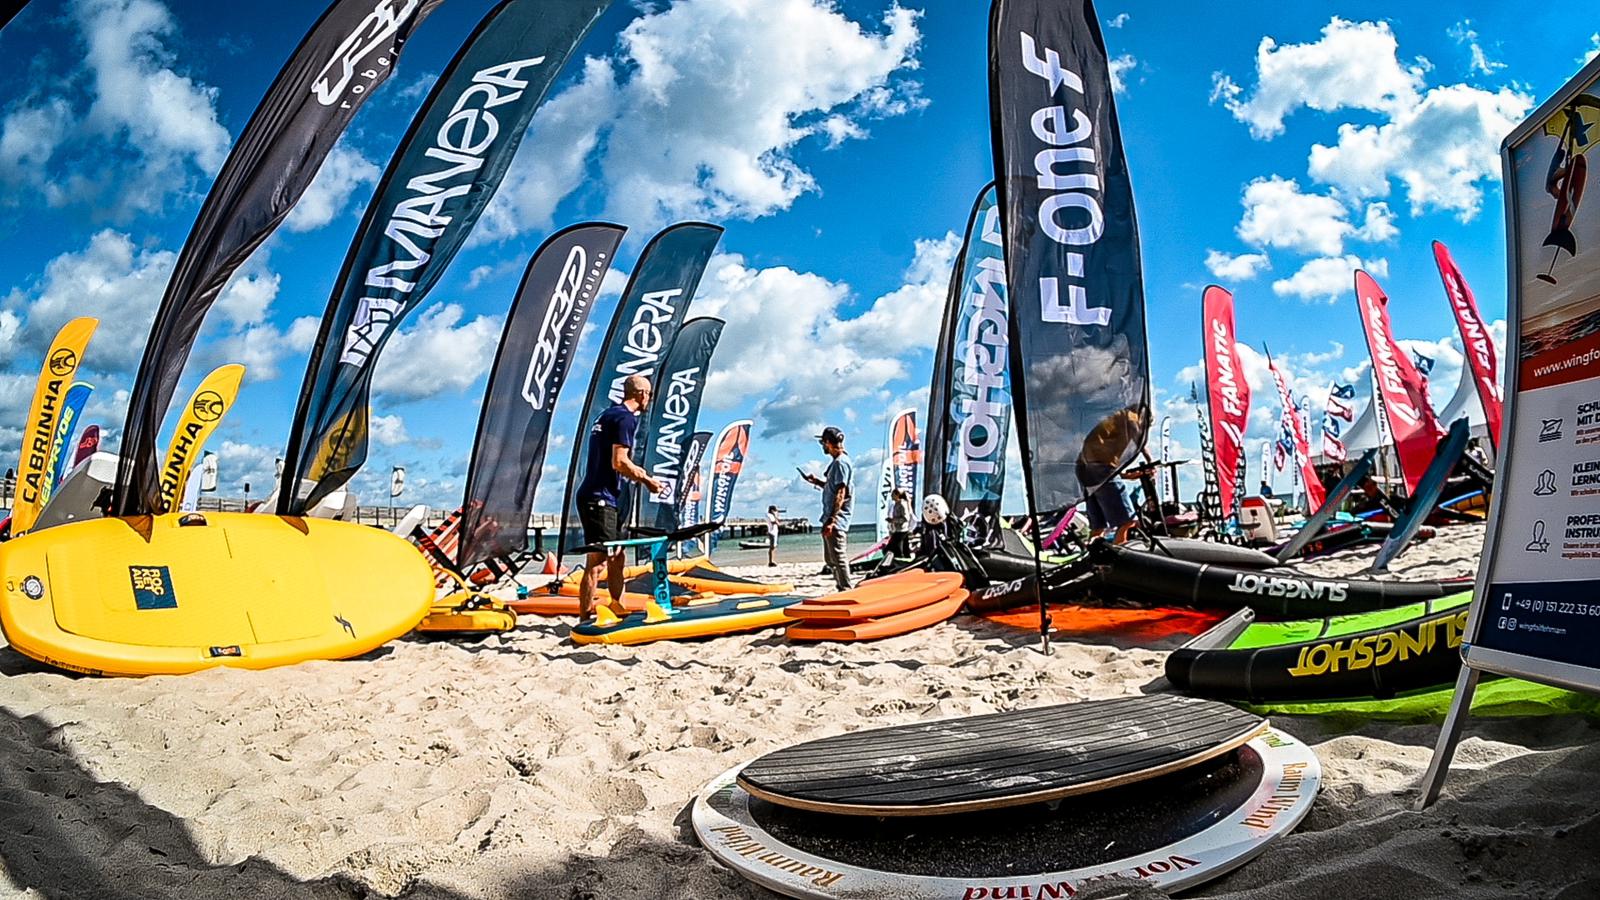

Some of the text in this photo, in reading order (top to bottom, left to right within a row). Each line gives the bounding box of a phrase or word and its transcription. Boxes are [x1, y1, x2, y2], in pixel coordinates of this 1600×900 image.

[1213, 319, 1244, 418] FANATIC
[1577, 414, 1594, 427] MIT
[22, 379, 63, 505] CABRINHA
[1573, 461, 1600, 474] KLEIN
[132, 567, 145, 590] AIR
[1228, 573, 1349, 602] SLINGSHOT
[1558, 602, 1575, 614] 222
[1575, 603, 1588, 615] 33
[1239, 794, 1300, 829] Wind
[710, 825, 845, 888] Raum Wind
[1130, 854, 1201, 879] Vor
